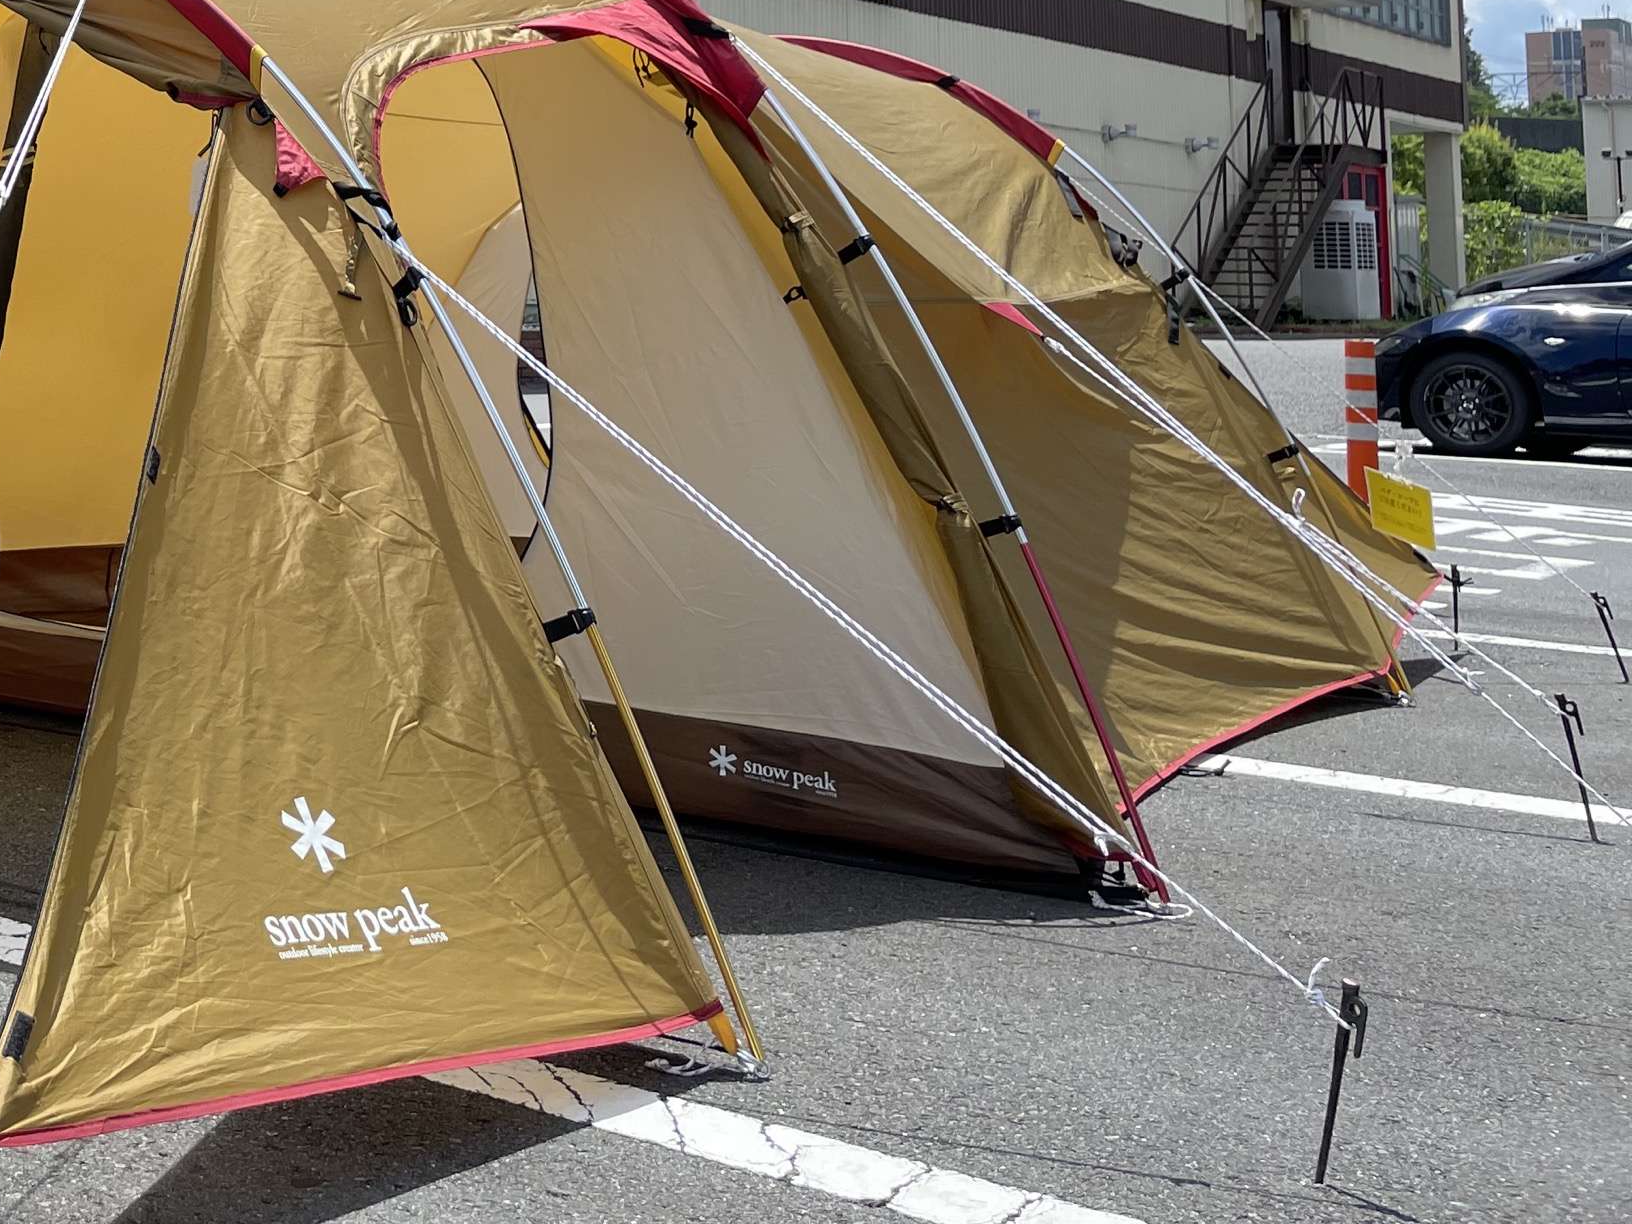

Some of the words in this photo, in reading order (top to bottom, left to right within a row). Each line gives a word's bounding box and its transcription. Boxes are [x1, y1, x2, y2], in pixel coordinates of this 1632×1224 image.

[743, 759, 789, 781] snow
[792, 771, 836, 792] peak
[264, 910, 350, 947] snow
[354, 886, 441, 952] peak
